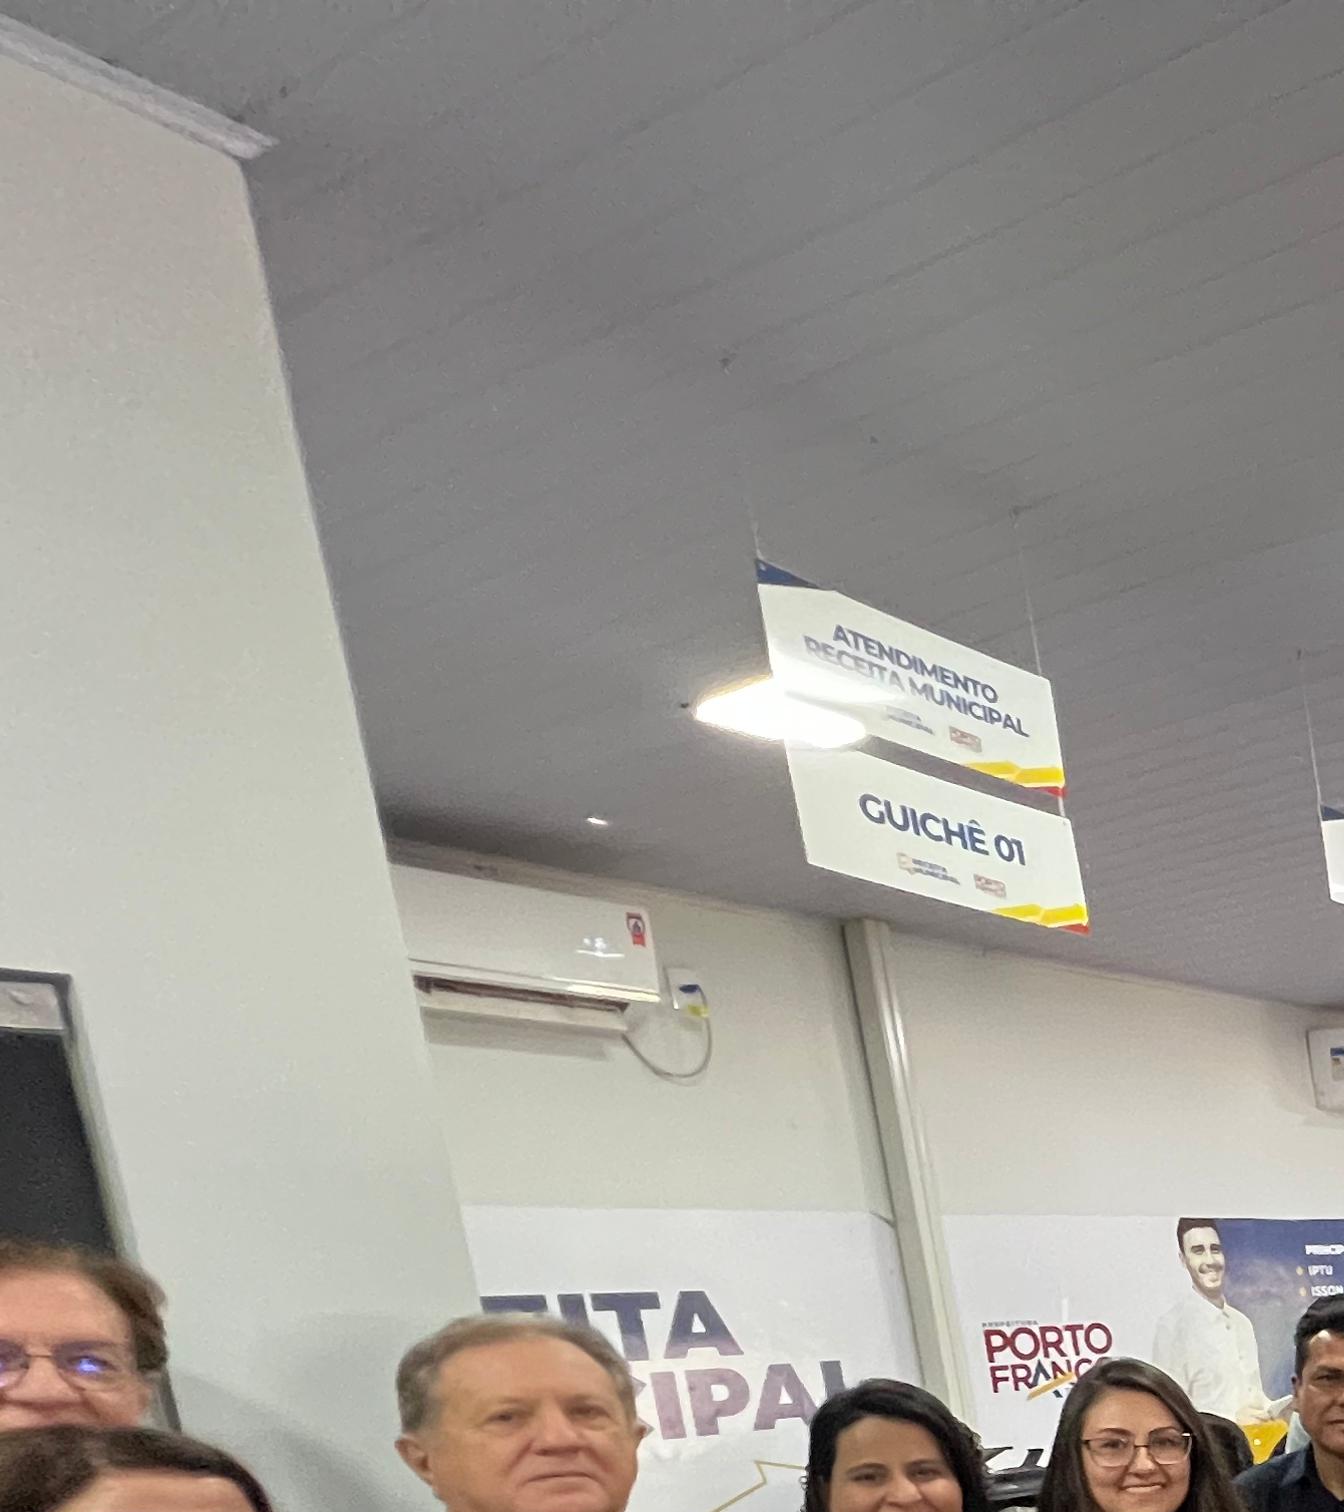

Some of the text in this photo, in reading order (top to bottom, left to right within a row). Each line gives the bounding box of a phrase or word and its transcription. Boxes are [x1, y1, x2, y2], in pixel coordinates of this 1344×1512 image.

[803, 635, 905, 692] RECEITA
[908, 677, 1030, 738] MUNICIPAL
[832, 624, 999, 703] ATENDIMENTO
[859, 793, 1026, 866] GUICHÊ 01
[1308, 1265, 1333, 1276] IPTU
[984, 1322, 1112, 1363] PORTO
[990, 1357, 1094, 1394] FRANC
